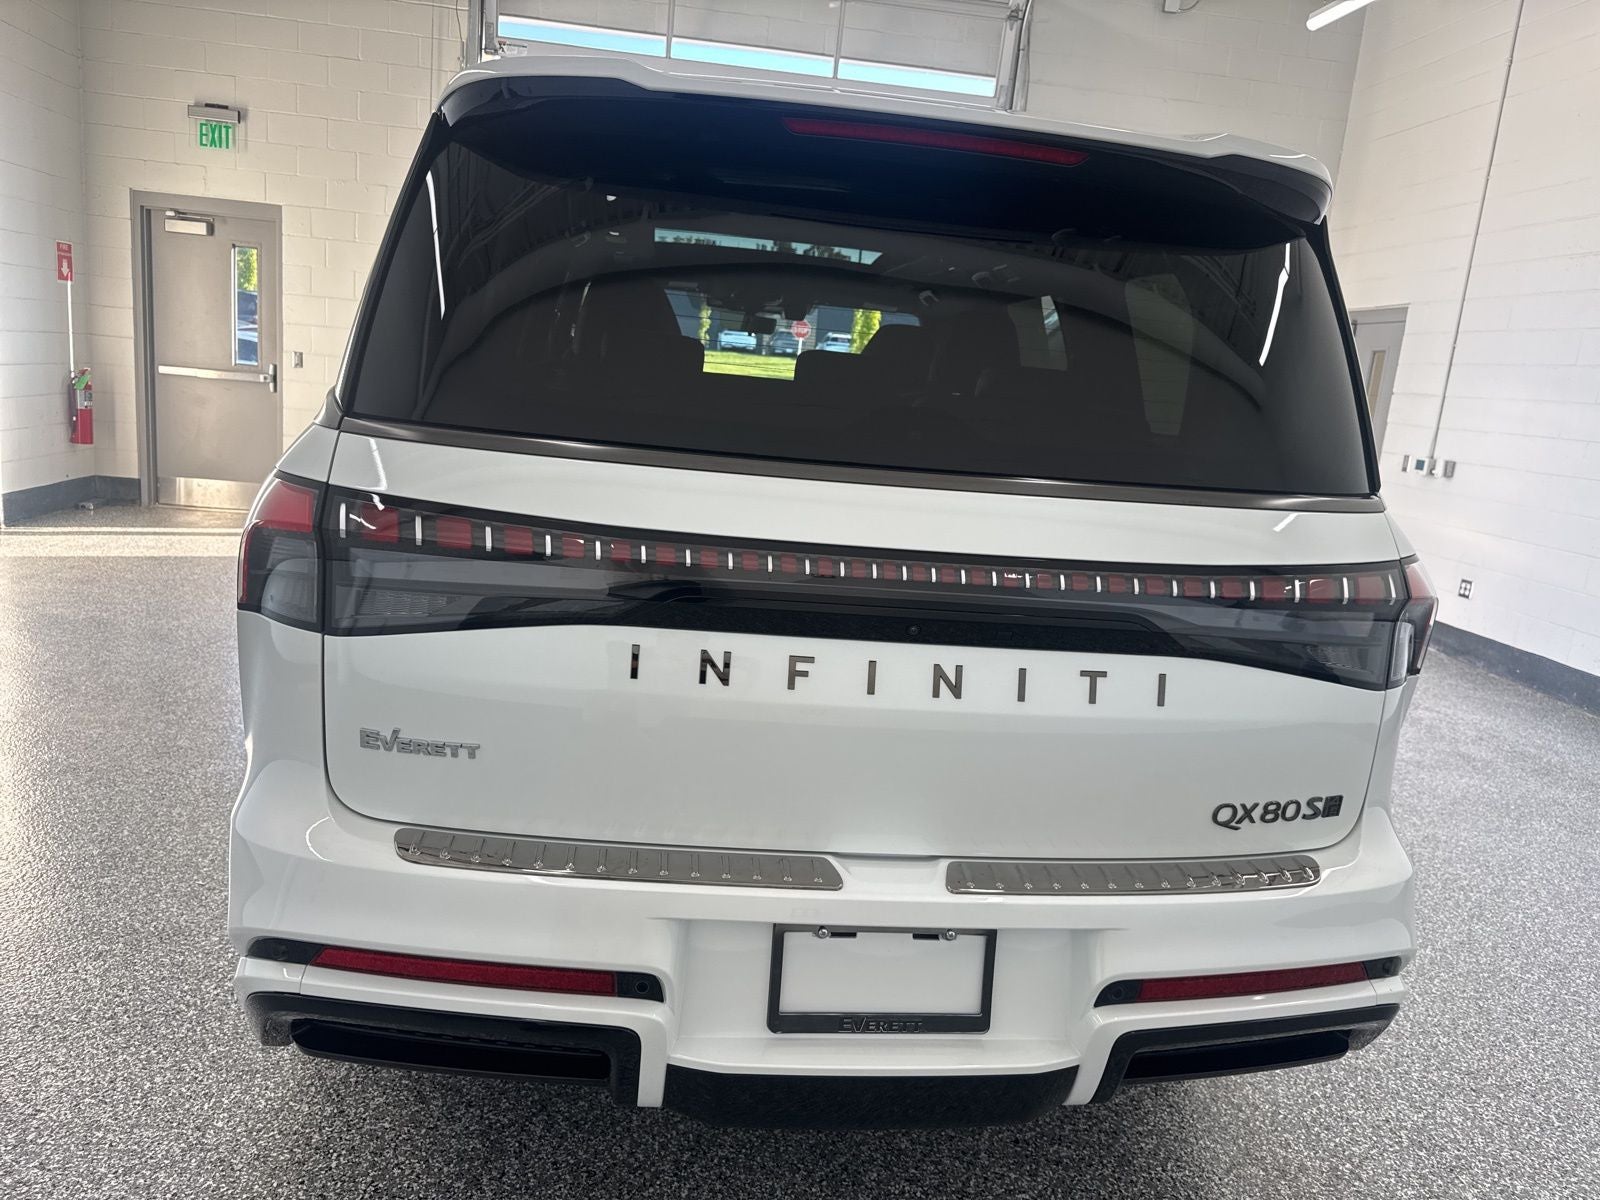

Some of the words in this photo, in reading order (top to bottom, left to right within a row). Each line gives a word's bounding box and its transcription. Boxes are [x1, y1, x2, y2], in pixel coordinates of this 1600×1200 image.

[199, 122, 232, 149] EXIT
[630, 644, 1168, 708] INFINITI
[359, 727, 480, 760] EVERETT
[838, 1016, 924, 1033] EVERETT
